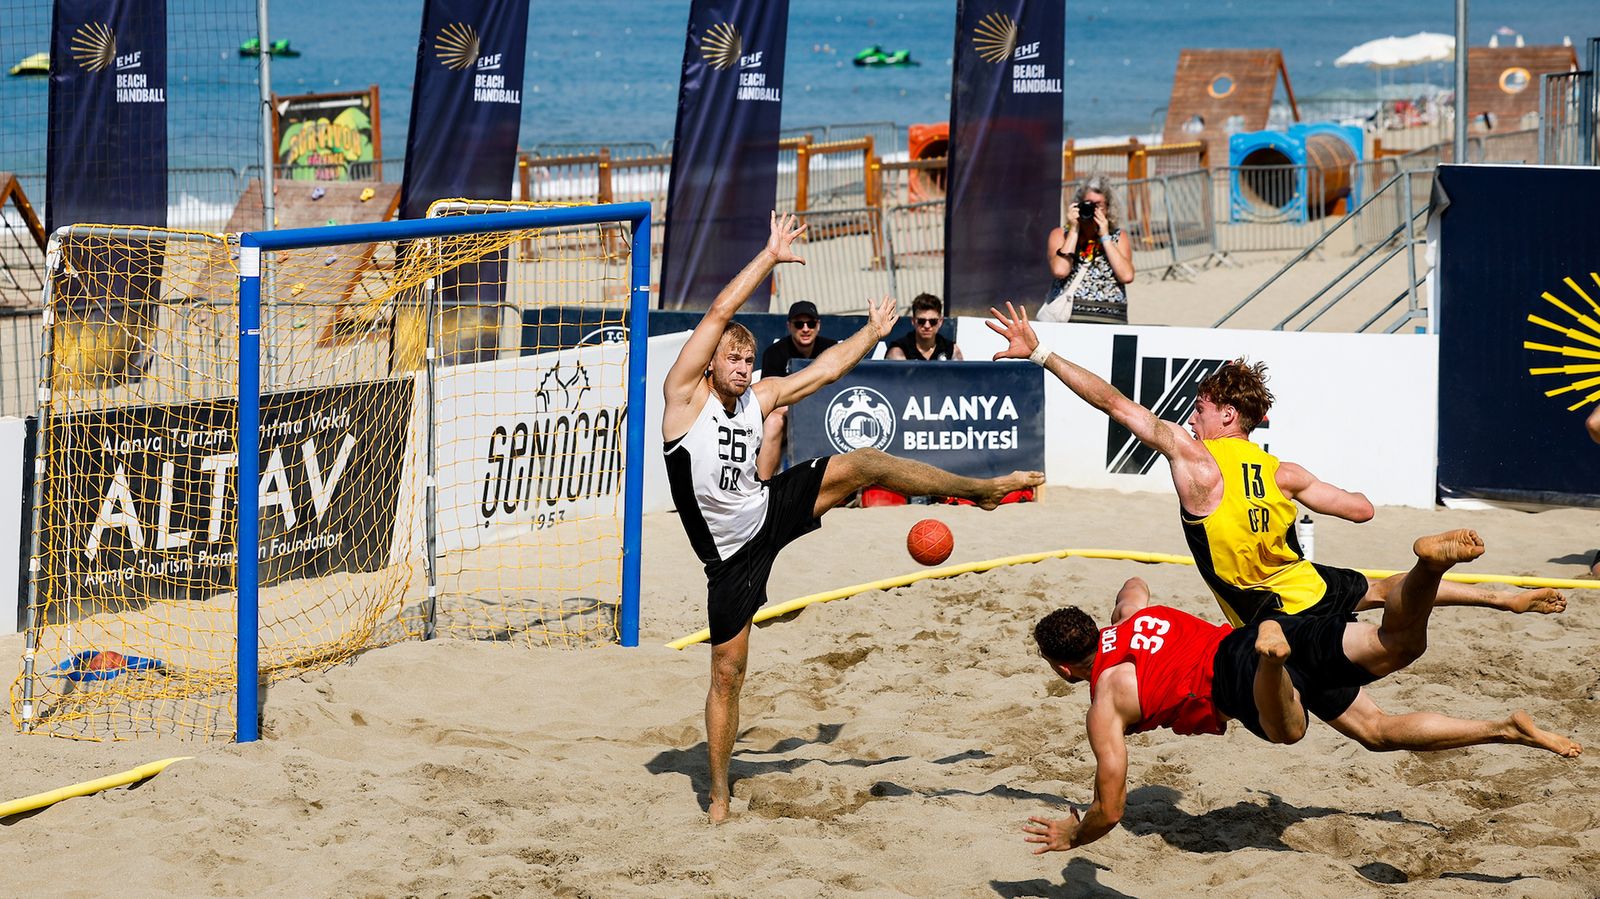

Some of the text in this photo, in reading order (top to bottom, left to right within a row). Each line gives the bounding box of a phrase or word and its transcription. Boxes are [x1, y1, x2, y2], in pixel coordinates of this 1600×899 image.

[1014, 41, 1040, 58] EHF
[116, 51, 141, 67] EHF
[477, 53, 502, 67] EHF
[740, 51, 763, 67] EHF
[1013, 64, 1045, 79] BEACH
[116, 74, 147, 88] BEACH
[475, 74, 505, 88] BEACH
[1013, 79, 1062, 93] HANDBALL
[116, 88, 165, 103] HANDBALL
[474, 88, 520, 104] HANDBALL
[737, 87, 780, 102] HANDBALL
[902, 395, 1019, 421] ALANYA
[100, 434, 162, 458] Alanya
[170, 425, 228, 449] Turizm
[718, 425, 747, 463] 26
[903, 426, 1019, 450] BELEDİYESİ
[1241, 462, 1266, 499] 13
[83, 432, 357, 562] ALTAV
[84, 566, 134, 587] Alanya
[139, 554, 193, 577] Tourism
[271, 529, 342, 557] Foundation
[1101, 626, 1118, 654] POR
[1130, 615, 1171, 655] 33
